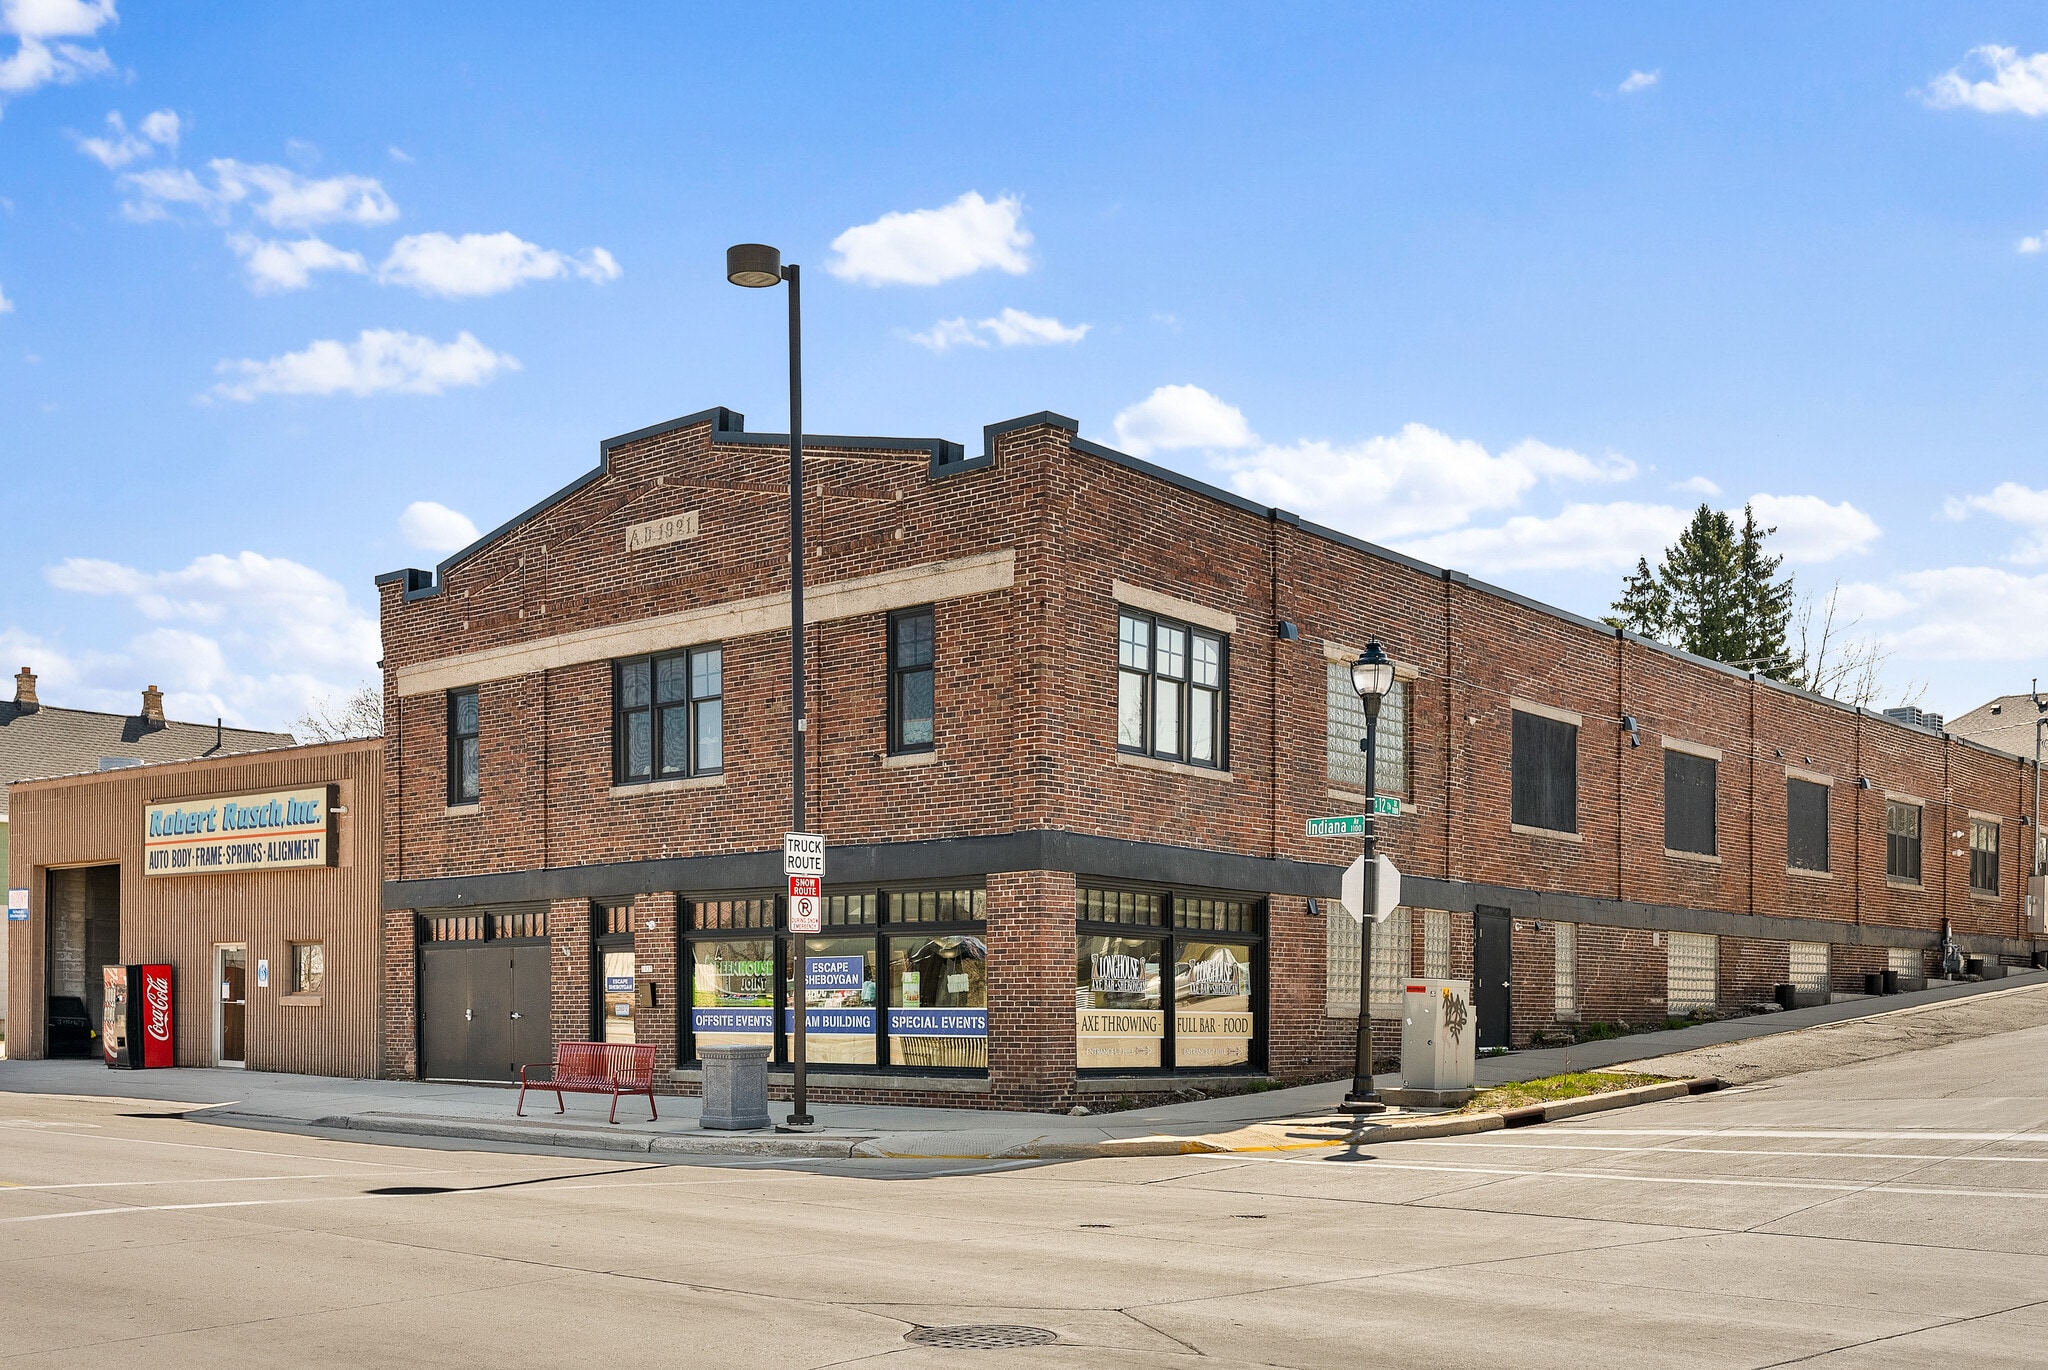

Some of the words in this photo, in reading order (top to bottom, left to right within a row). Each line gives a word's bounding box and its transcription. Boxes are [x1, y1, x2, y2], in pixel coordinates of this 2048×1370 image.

[149, 805, 217, 837] Robert
[1308, 819, 1347, 835] Indiana
[1350, 824, 1362, 833] 1100
[788, 839, 821, 854] TRUCK
[149, 850, 169, 870] AUTO
[788, 855, 821, 870] ROUTE
[795, 878, 816, 887] SNOW
[793, 886, 817, 896] ROUTE
[812, 961, 849, 973] ESCAPE
[1099, 954, 1140, 980] LONGHOUSE
[740, 977, 767, 991] JOINT
[805, 973, 859, 985] SHEBOYGAN
[695, 1014, 734, 1027] OFFSITE
[735, 1015, 773, 1027] EVENTS
[792, 1015, 820, 1027] AM
[822, 1015, 871, 1027] BUILDING
[892, 1015, 939, 1029] SPECIAL
[941, 1016, 986, 1029] EVENTS
[1081, 1015, 1100, 1032] AXE
[1101, 1016, 1157, 1033] THROWING
[1177, 1017, 1198, 1033] FULL
[1199, 1017, 1216, 1033] BAR
[1223, 1017, 1249, 1033] FOOD
